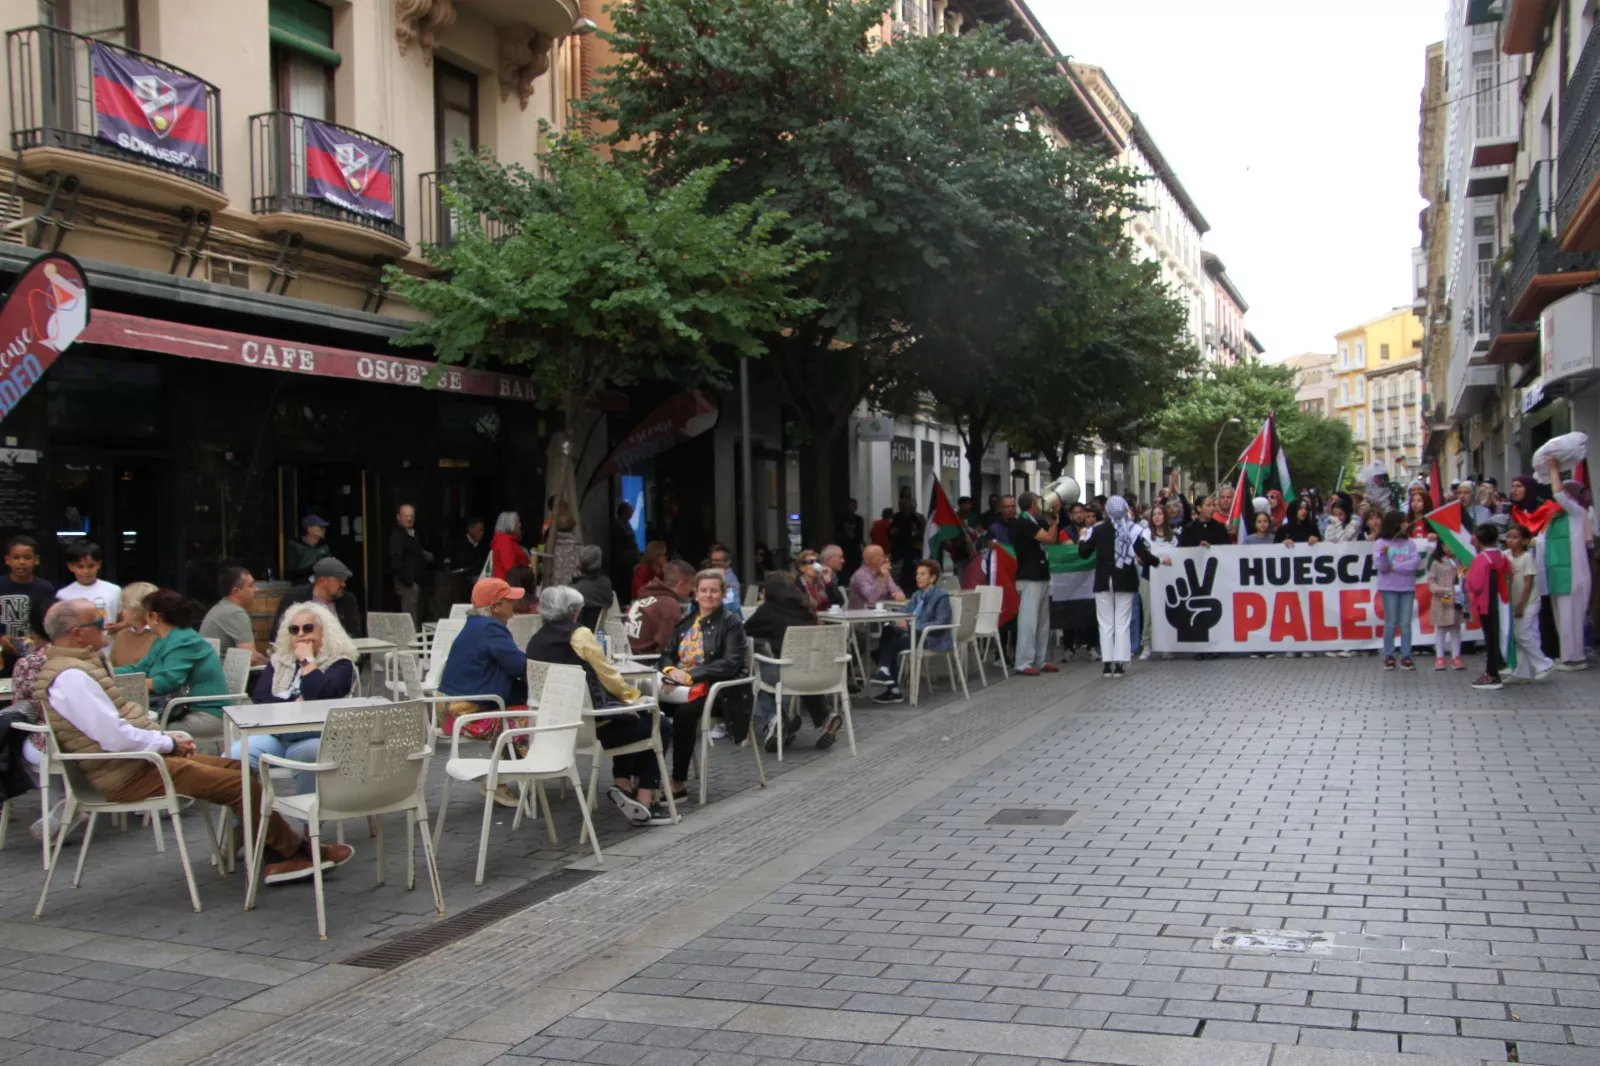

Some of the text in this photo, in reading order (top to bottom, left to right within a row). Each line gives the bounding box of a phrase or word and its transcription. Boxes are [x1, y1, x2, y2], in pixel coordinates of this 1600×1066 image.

[242, 341, 535, 399] CAFE OSCESE BAR
